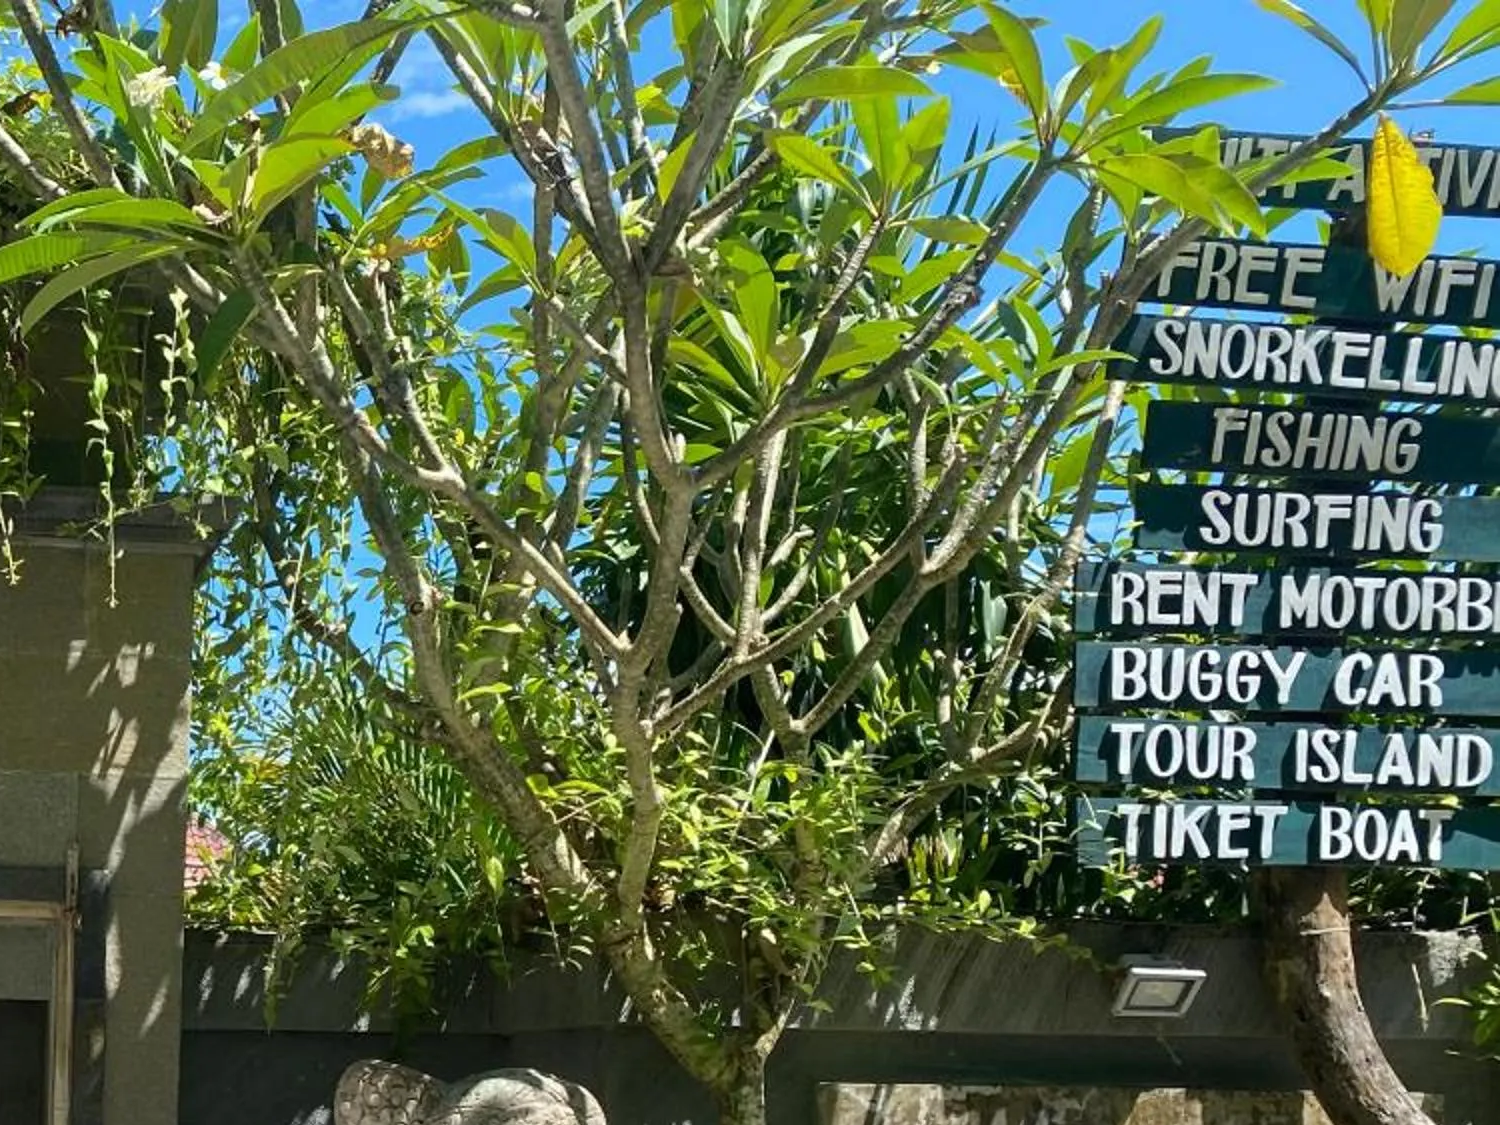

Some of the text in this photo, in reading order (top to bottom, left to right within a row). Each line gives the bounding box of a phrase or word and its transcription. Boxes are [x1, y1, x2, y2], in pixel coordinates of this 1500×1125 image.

[1157, 241, 1496, 319] FREE WIFI
[1211, 407, 1423, 475] FISHING
[1200, 490, 1444, 554] SURFING
[1111, 571, 1258, 628] RENT
[1110, 646, 1445, 708] BUGGY CAR
[1111, 722, 1493, 788] TOUR ISLAND
[1117, 803, 1455, 862] TIKET BOAT
